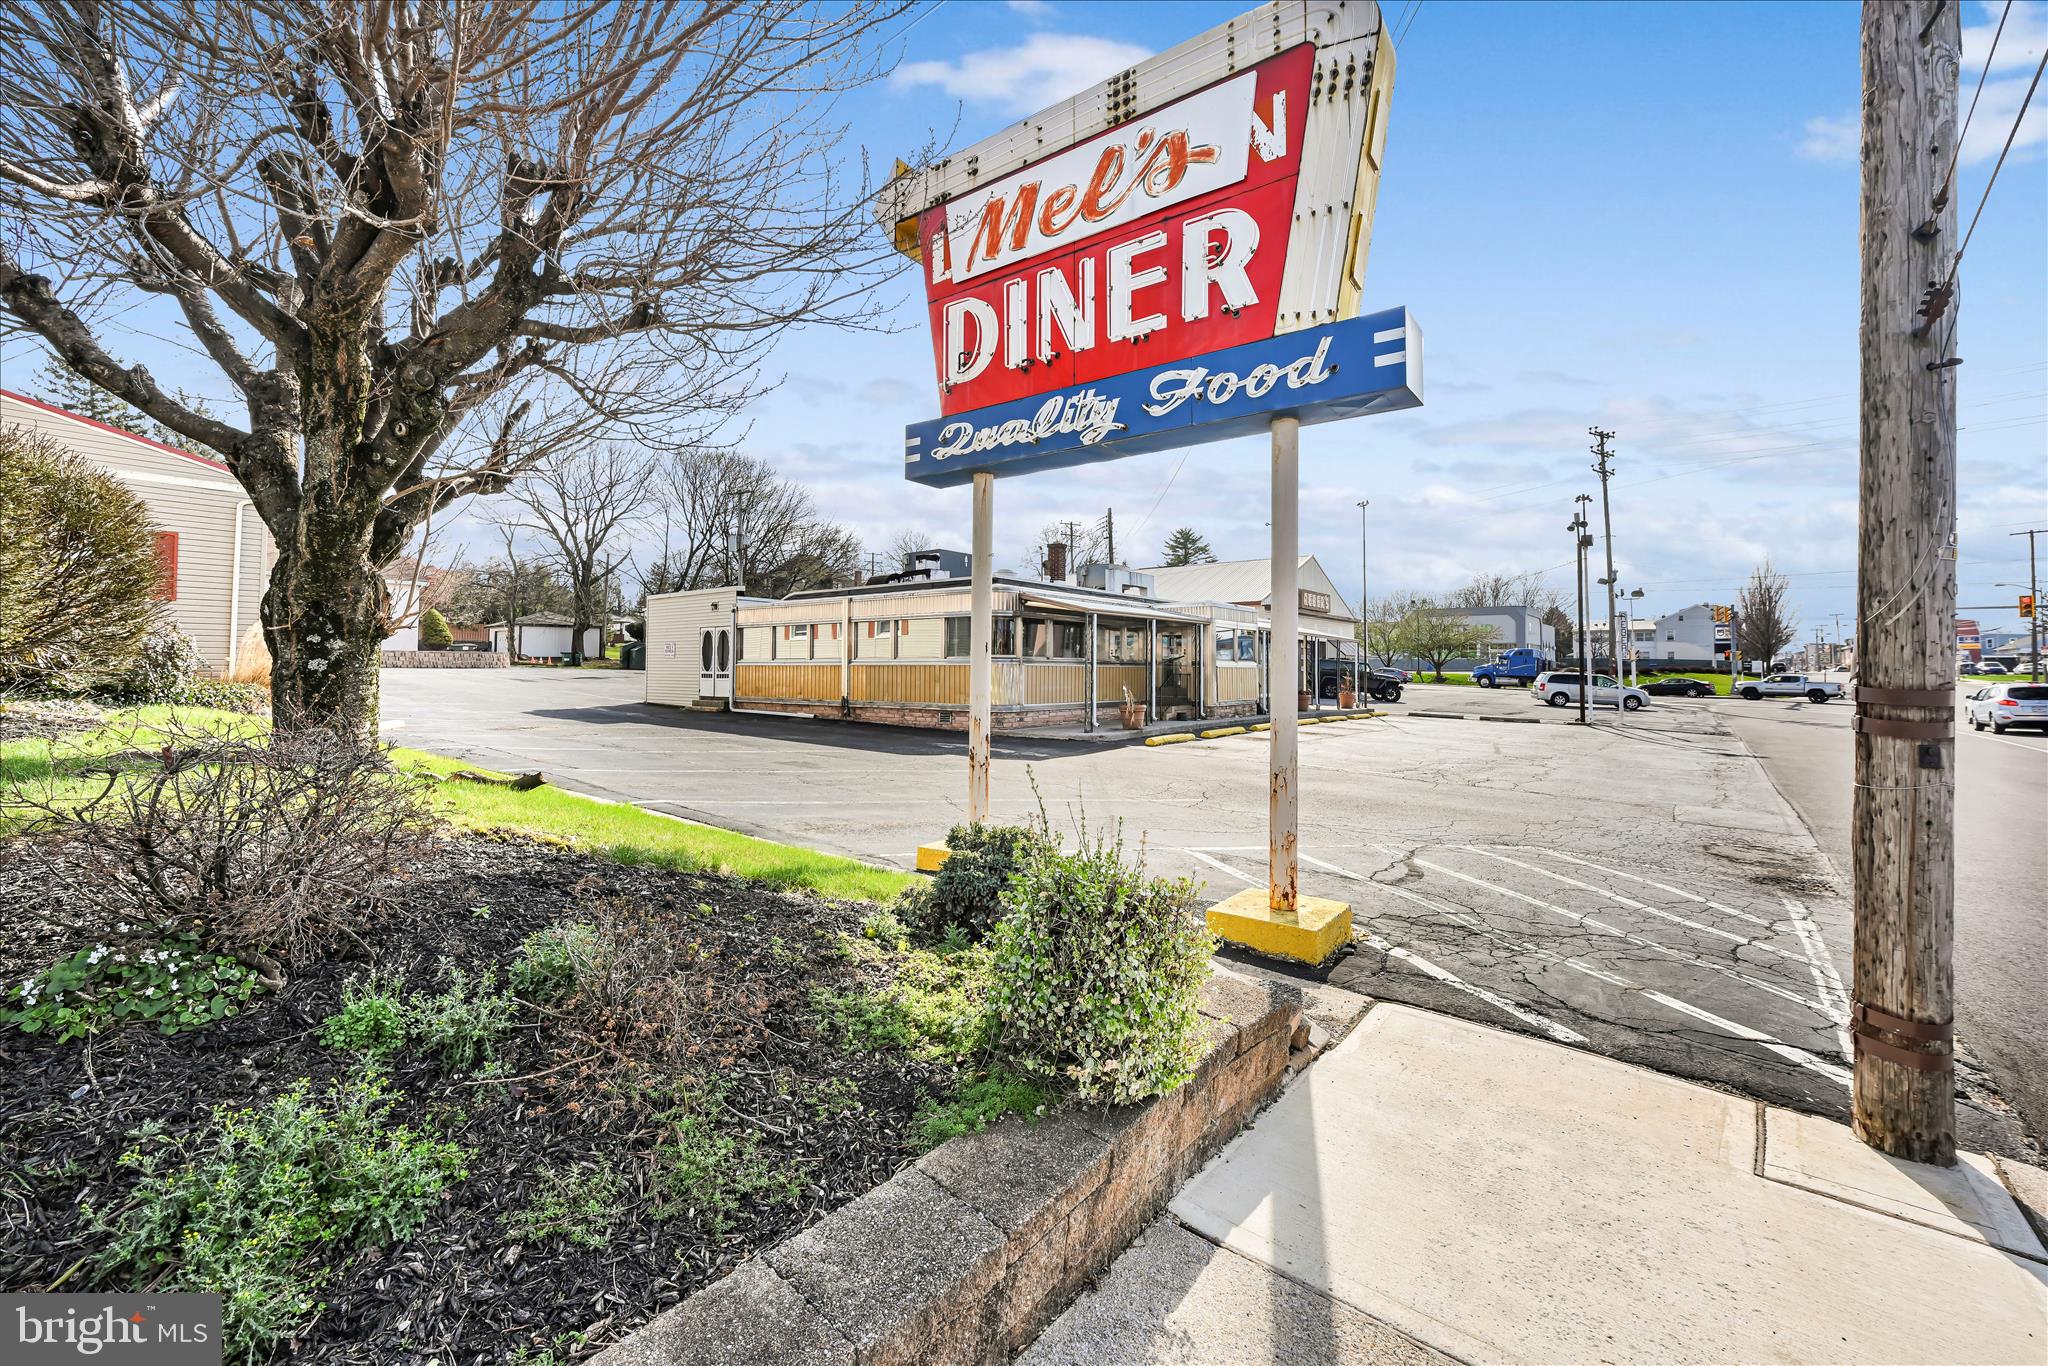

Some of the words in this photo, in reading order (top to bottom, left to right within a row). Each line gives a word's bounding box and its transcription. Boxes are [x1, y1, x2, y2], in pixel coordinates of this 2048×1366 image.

[966, 125, 1222, 273] Mel's
[942, 207, 1261, 392] DINER
[931, 388, 1127, 460] Quality
[1142, 336, 1334, 417] Food
